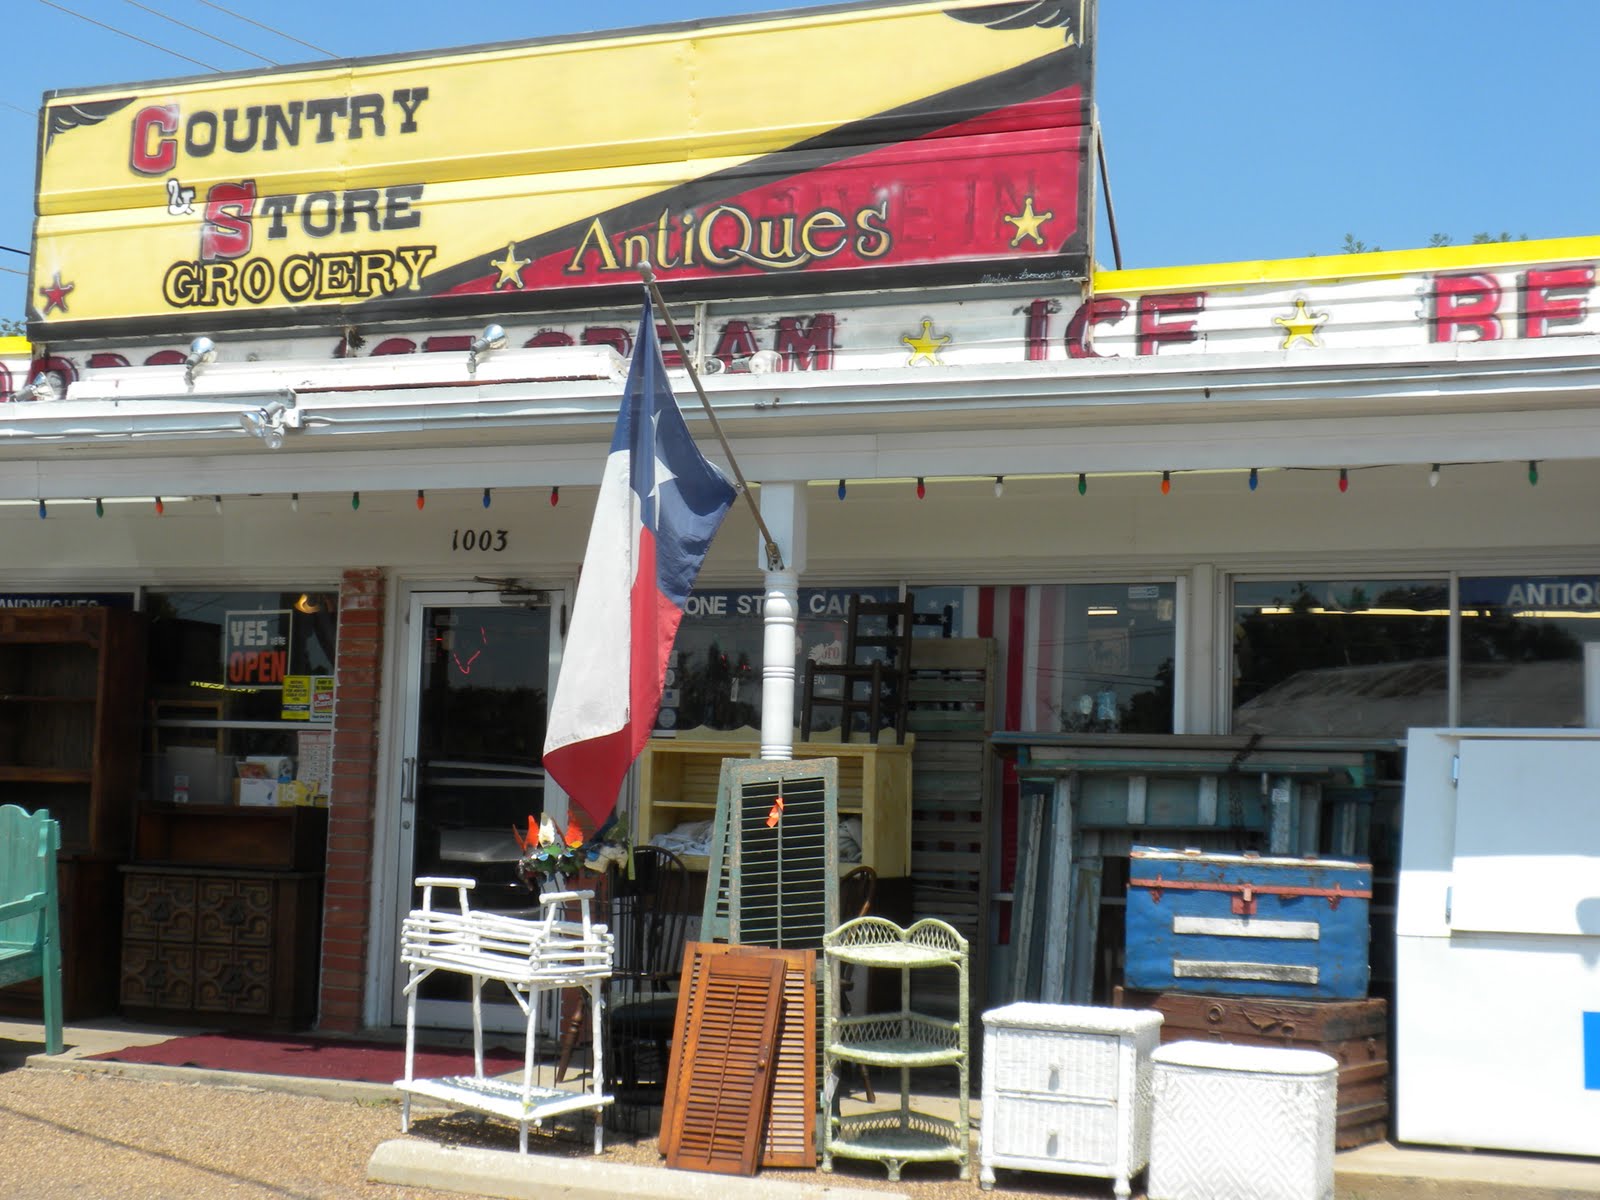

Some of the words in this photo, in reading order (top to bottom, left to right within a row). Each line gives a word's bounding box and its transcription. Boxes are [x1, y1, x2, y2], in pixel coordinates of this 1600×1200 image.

[131, 87, 430, 174] COUNTRY
[167, 178, 195, 216] &
[202, 180, 425, 260] STORE
[565, 198, 893, 272] AntiQues
[163, 245, 436, 307] GROCERY
[452, 529, 508, 551] 1003
[684, 595, 727, 615] ONE
[231, 620, 268, 646] YES
[229, 651, 287, 683] OPEN
